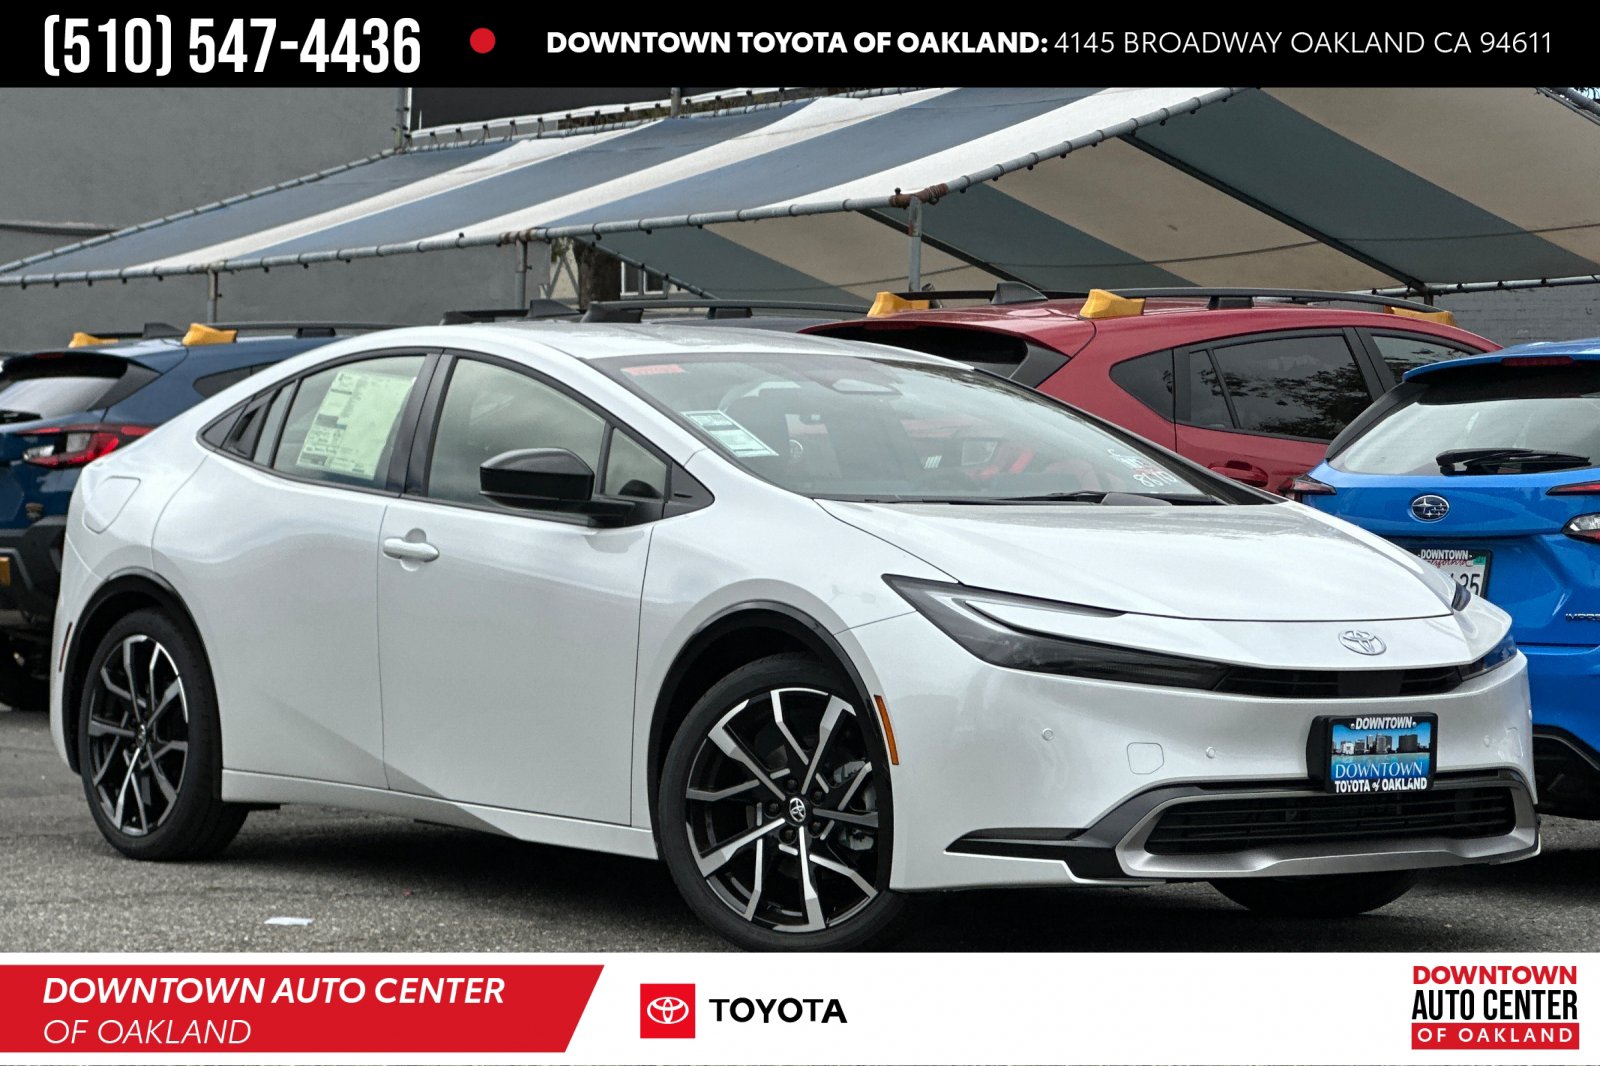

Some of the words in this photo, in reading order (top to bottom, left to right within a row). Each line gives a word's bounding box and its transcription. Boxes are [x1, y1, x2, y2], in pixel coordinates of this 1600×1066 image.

[1420, 549, 1469, 560] DOWNTOWN
[1355, 716, 1413, 730] DOWNTOWN
[1335, 761, 1423, 779] DOWNTOWN
[1334, 779, 1371, 793] TOYOTA
[1381, 777, 1428, 791] OAKLAND
